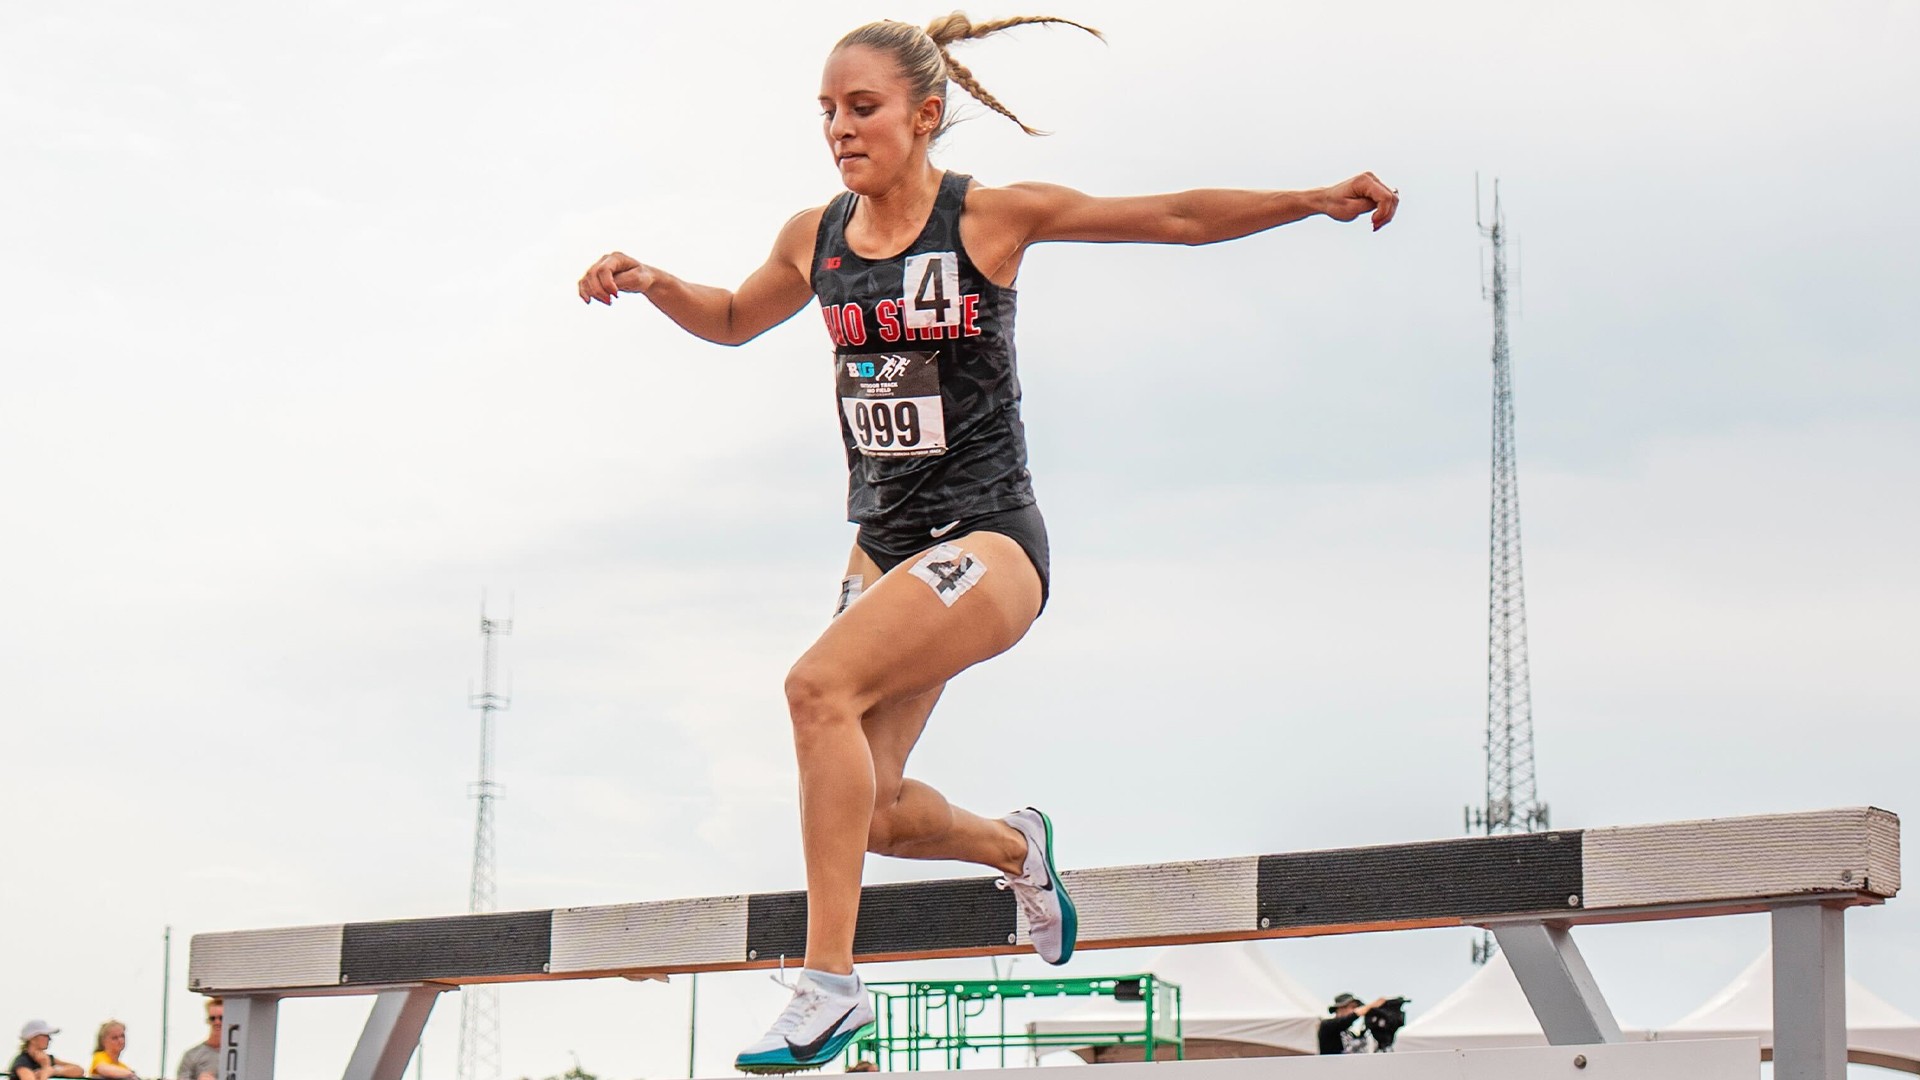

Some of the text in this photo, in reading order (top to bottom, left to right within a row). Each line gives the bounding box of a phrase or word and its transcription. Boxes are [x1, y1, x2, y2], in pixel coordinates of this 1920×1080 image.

[914, 258, 951, 323] 4
[822, 303, 867, 347] IO
[855, 401, 921, 447] 999
